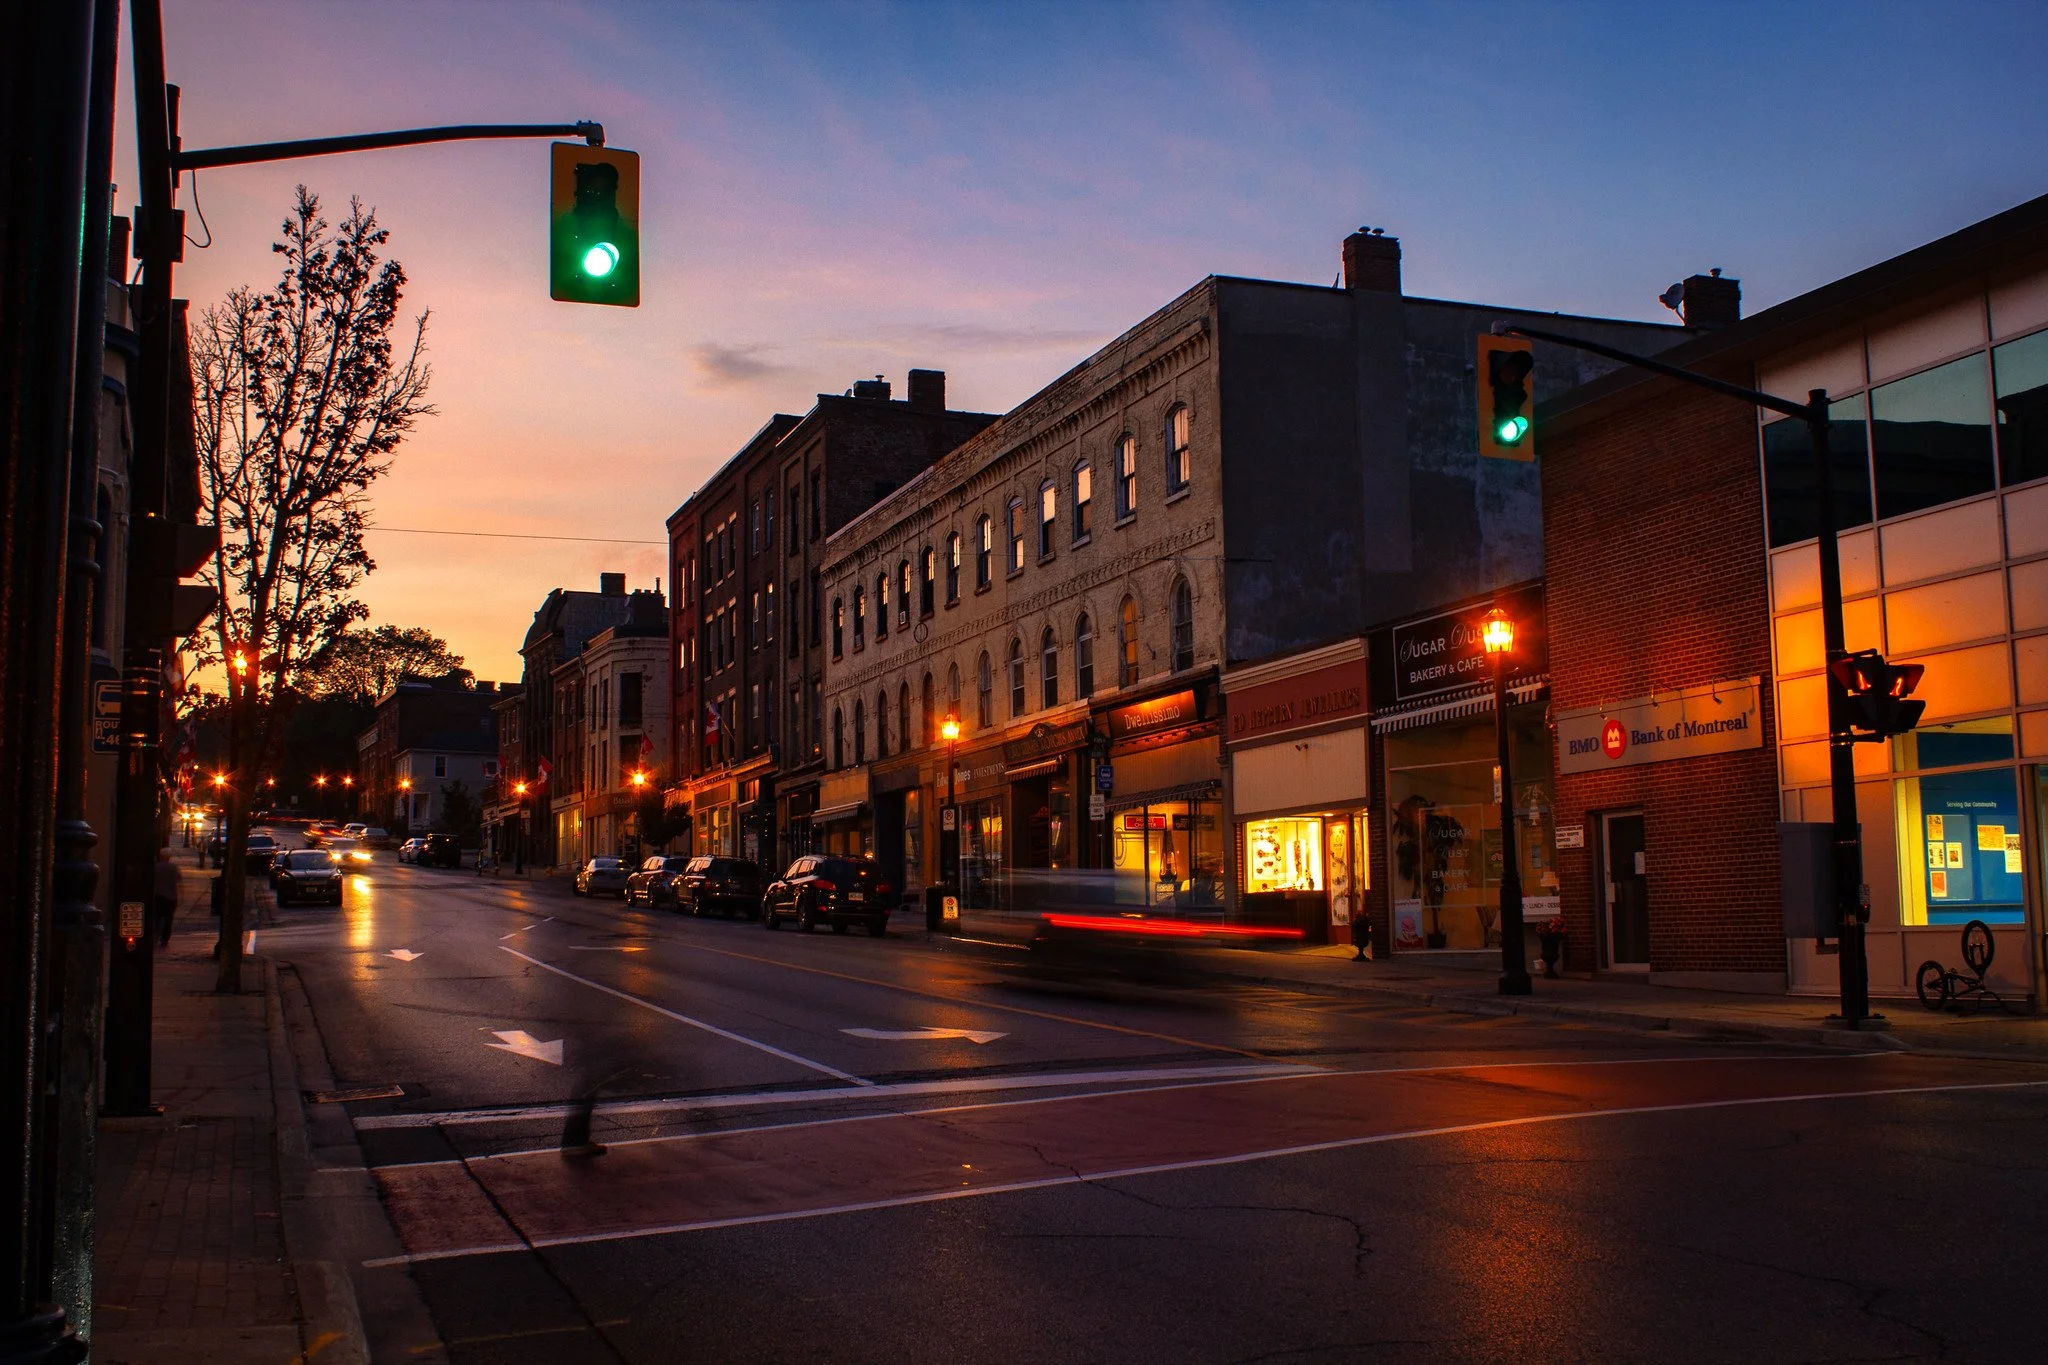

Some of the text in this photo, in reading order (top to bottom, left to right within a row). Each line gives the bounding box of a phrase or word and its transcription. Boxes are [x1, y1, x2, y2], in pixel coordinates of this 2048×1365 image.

[1399, 622, 1483, 663] SUGAR DUS
[1409, 663, 1448, 684] BAKERY
[1448, 664, 1455, 674] &
[1232, 712, 1245, 734] ED
[1569, 712, 1748, 755] BMO Bank of Montreal
[1431, 868, 1471, 879] BAKERY
